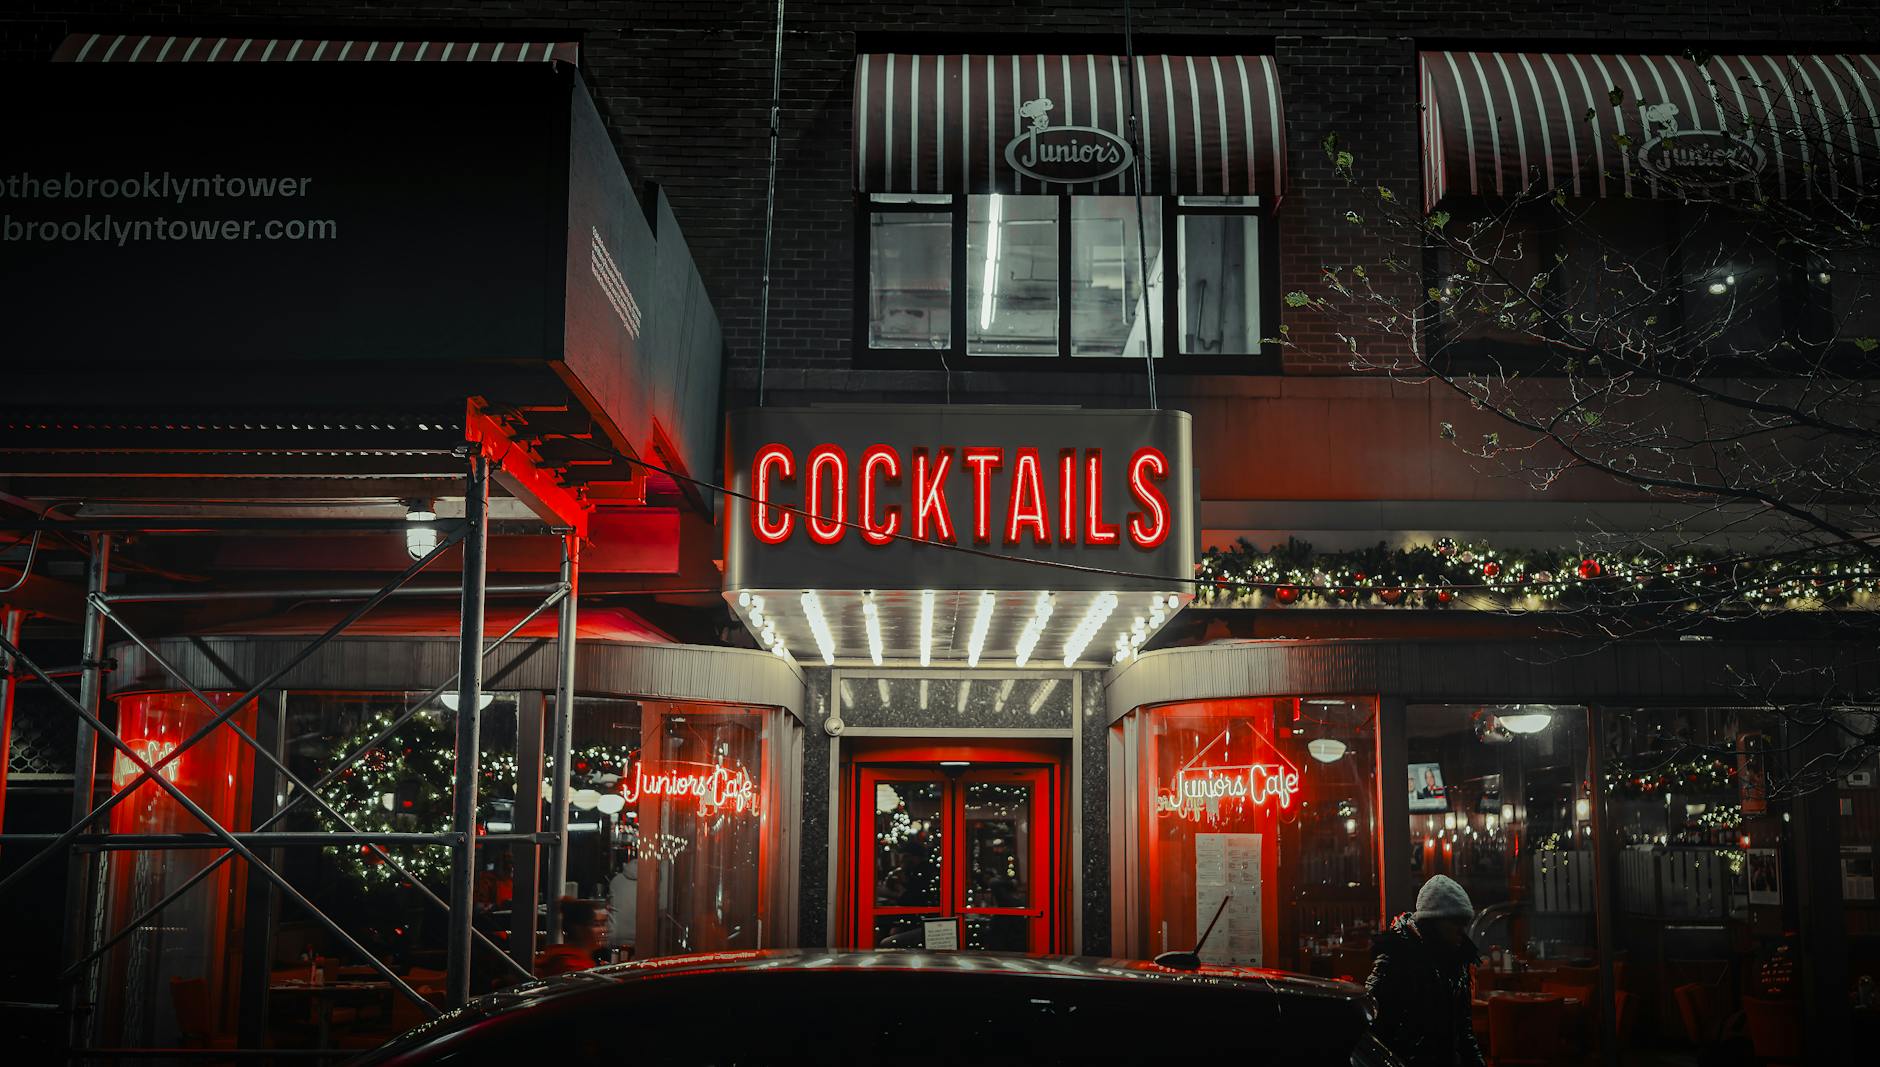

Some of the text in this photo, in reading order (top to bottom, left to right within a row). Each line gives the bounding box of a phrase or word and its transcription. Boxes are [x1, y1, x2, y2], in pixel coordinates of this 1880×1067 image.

[1020, 125, 1120, 168] Junior's
[3, 214, 337, 247] brooklyntower.com
[751, 443, 1172, 549] COCKTAILS
